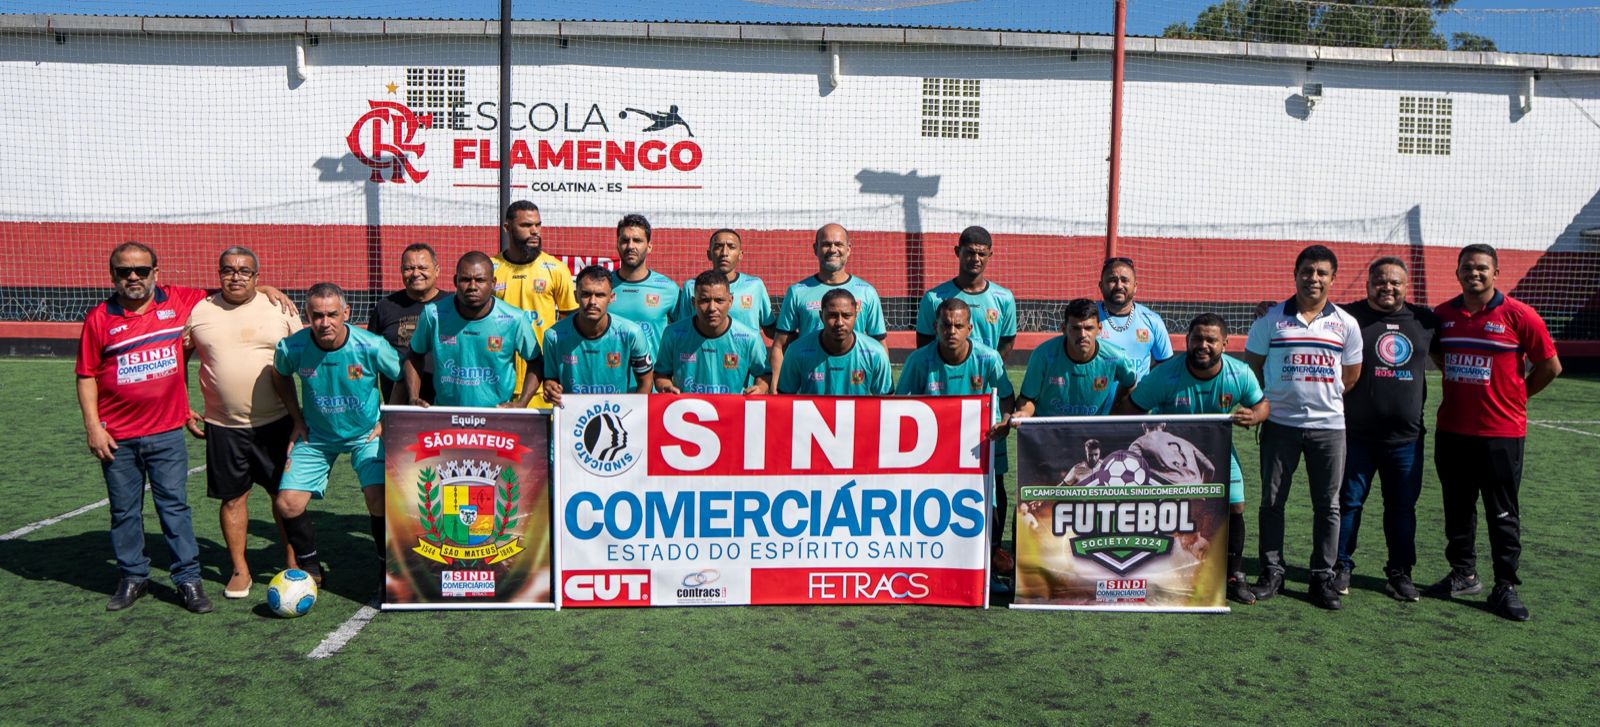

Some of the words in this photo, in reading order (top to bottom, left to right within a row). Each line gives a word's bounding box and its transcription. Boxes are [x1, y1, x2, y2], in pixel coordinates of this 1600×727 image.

[452, 101, 609, 133] ESCOLA
[453, 138, 703, 172] FLAMENGO
[532, 181, 596, 193] COLATINA
[607, 182, 623, 193] ES
[1450, 354, 1492, 369] SINDI
[451, 366, 494, 382] samp
[451, 415, 486, 426] Equipe
[573, 400, 621, 437] CIDADÃO
[423, 433, 453, 449] SÃO
[456, 433, 515, 450] MATEUS
[660, 399, 982, 472] SINDI
[574, 442, 633, 472] SINDICATO
[1032, 487, 1088, 497] CAMPEONATO
[1088, 487, 1130, 496] ESTADUAL
[1130, 485, 1209, 496] SINDICOMERCIÁRIOS
[1209, 486, 1222, 495] DE
[564, 480, 985, 540] COMERCIÁRIOS
[1054, 501, 1195, 535] FUTEBOL
[608, 543, 700, 562] ESTADO
[708, 543, 742, 561] DO
[750, 538, 860, 561] ESPÍRITO
[867, 541, 945, 561] SANTO
[1081, 536, 1130, 548] SOCIETY
[1135, 536, 1162, 547] 2024
[464, 546, 497, 557] MATEUS
[453, 571, 495, 581] SINDI
[676, 587, 721, 598] contracs
[808, 572, 930, 600] FETRACS
[1107, 580, 1146, 589] SINDI
